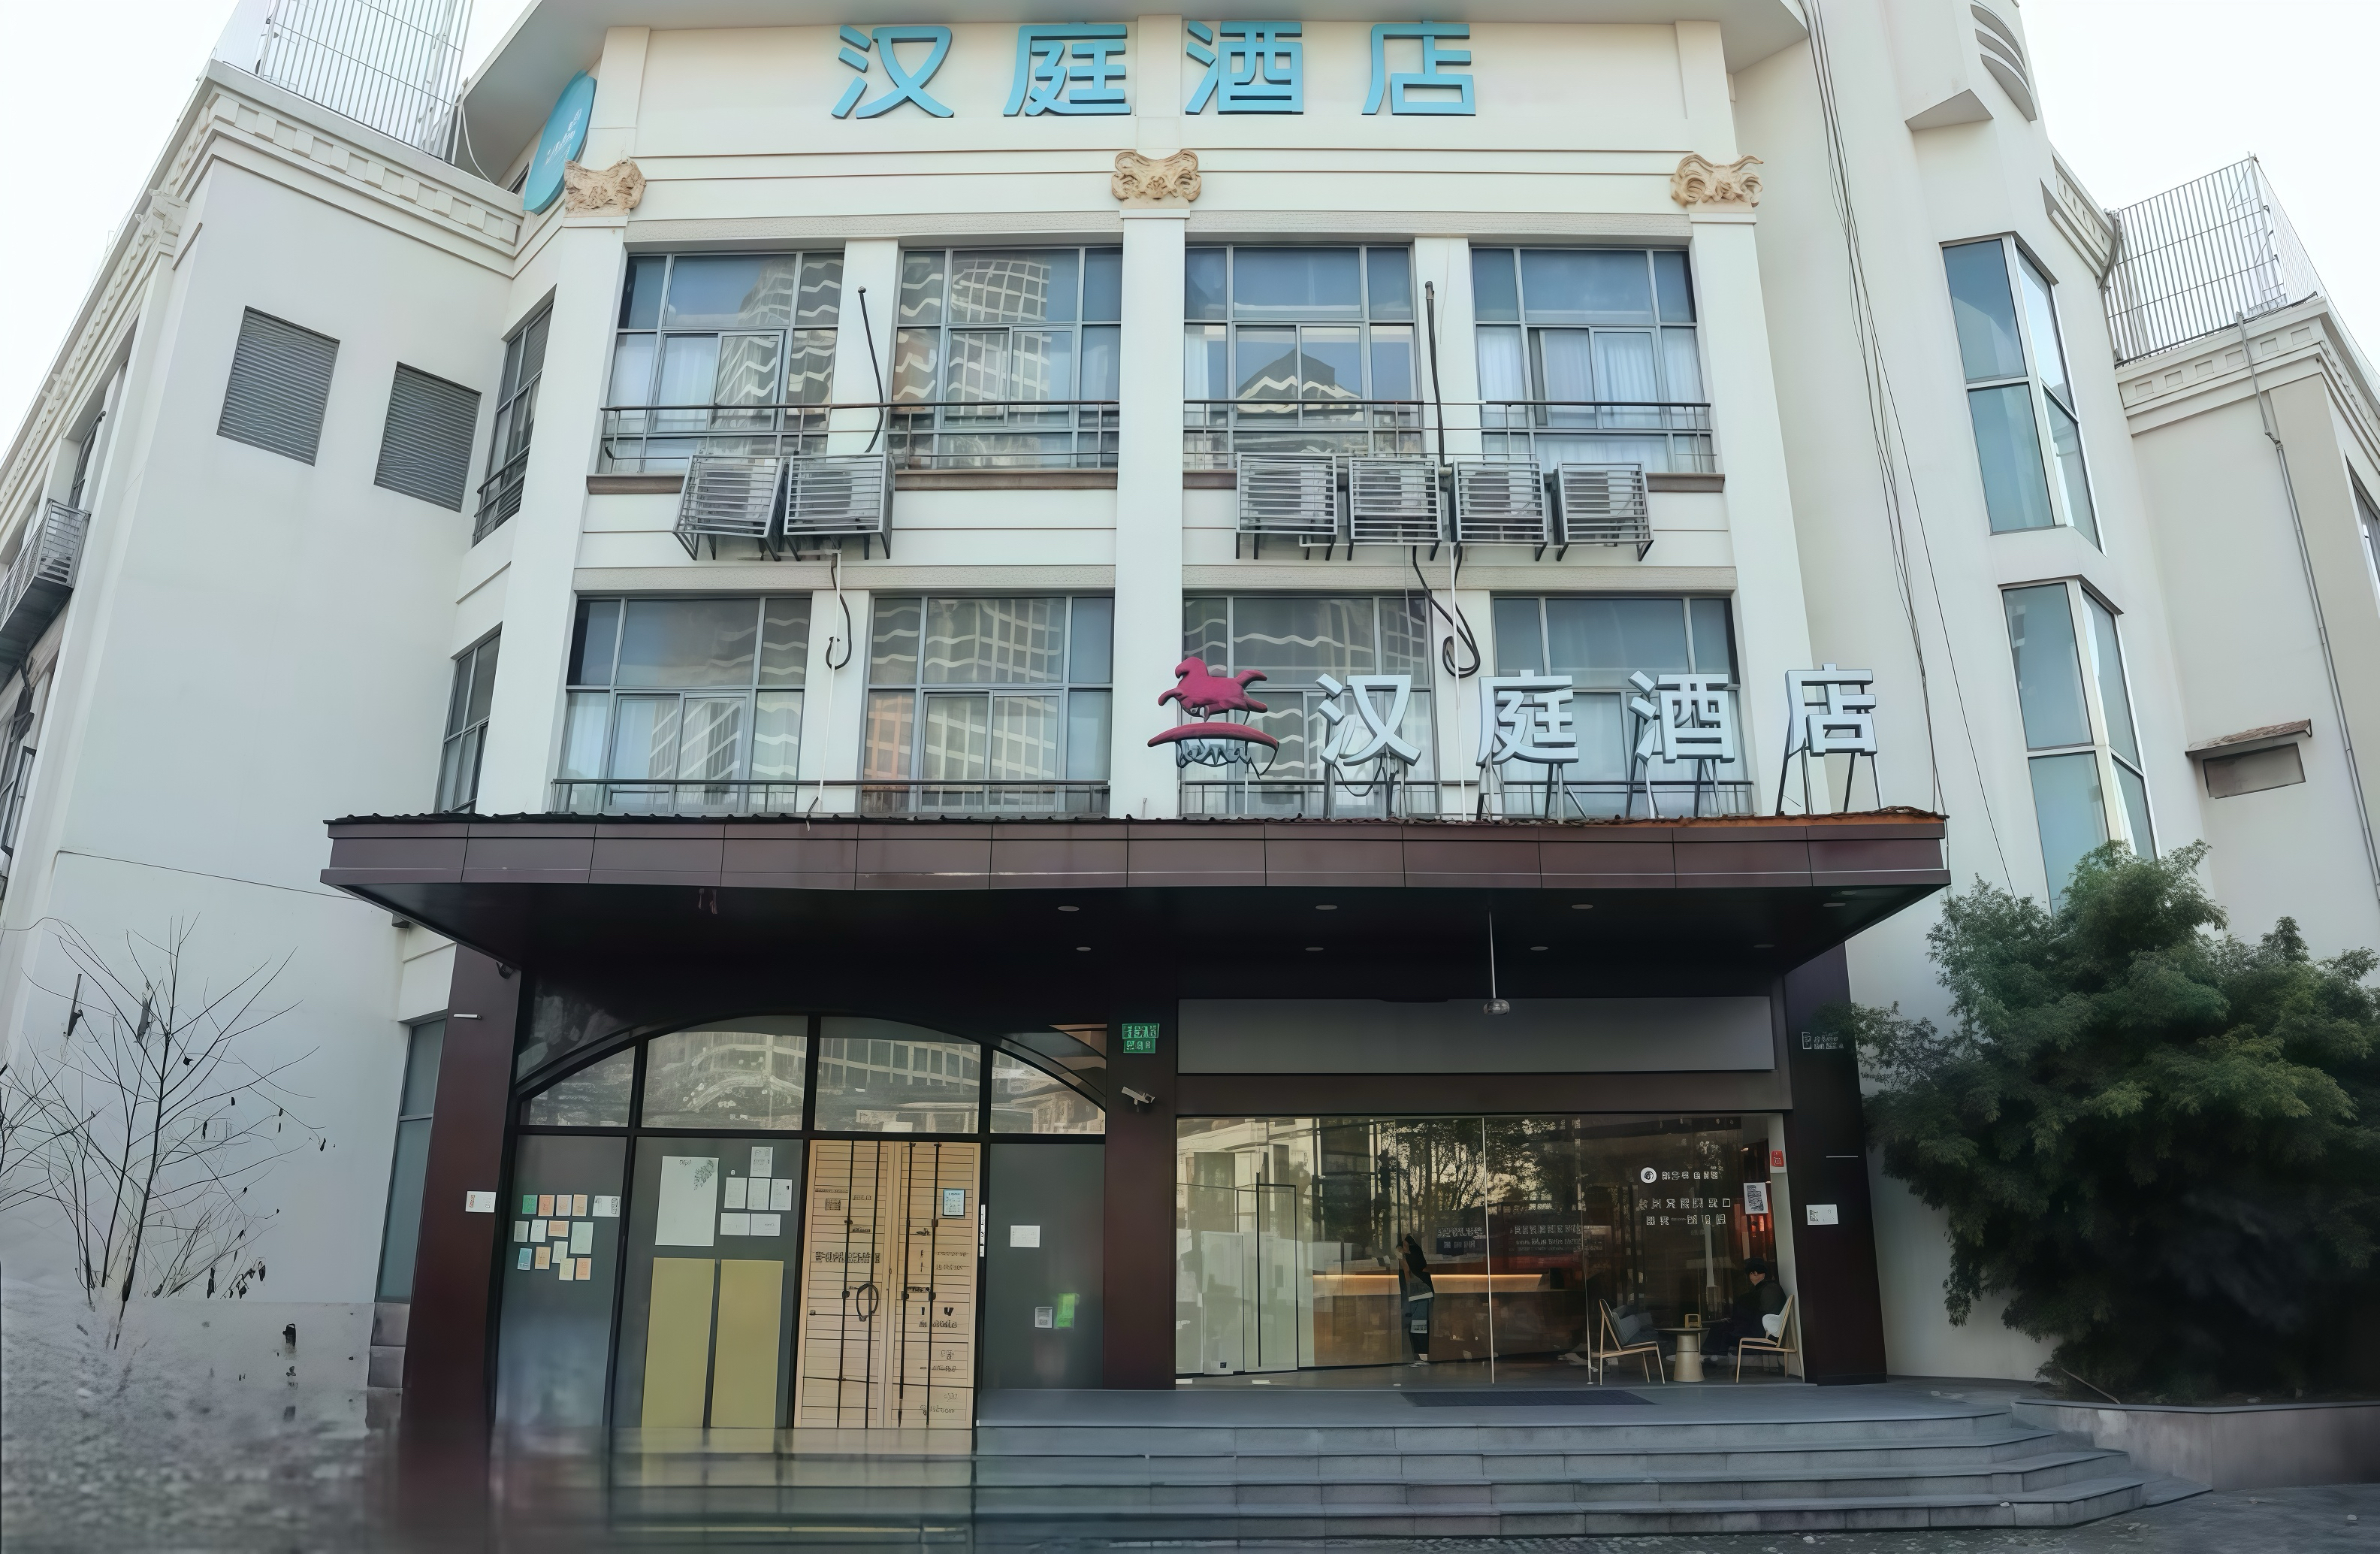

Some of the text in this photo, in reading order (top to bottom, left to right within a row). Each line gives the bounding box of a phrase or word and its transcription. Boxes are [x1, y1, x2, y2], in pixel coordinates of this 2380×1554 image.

[831, 20, 1475, 119] 汉庭酒店
[1316, 664, 1877, 766] 汉庭酒店
